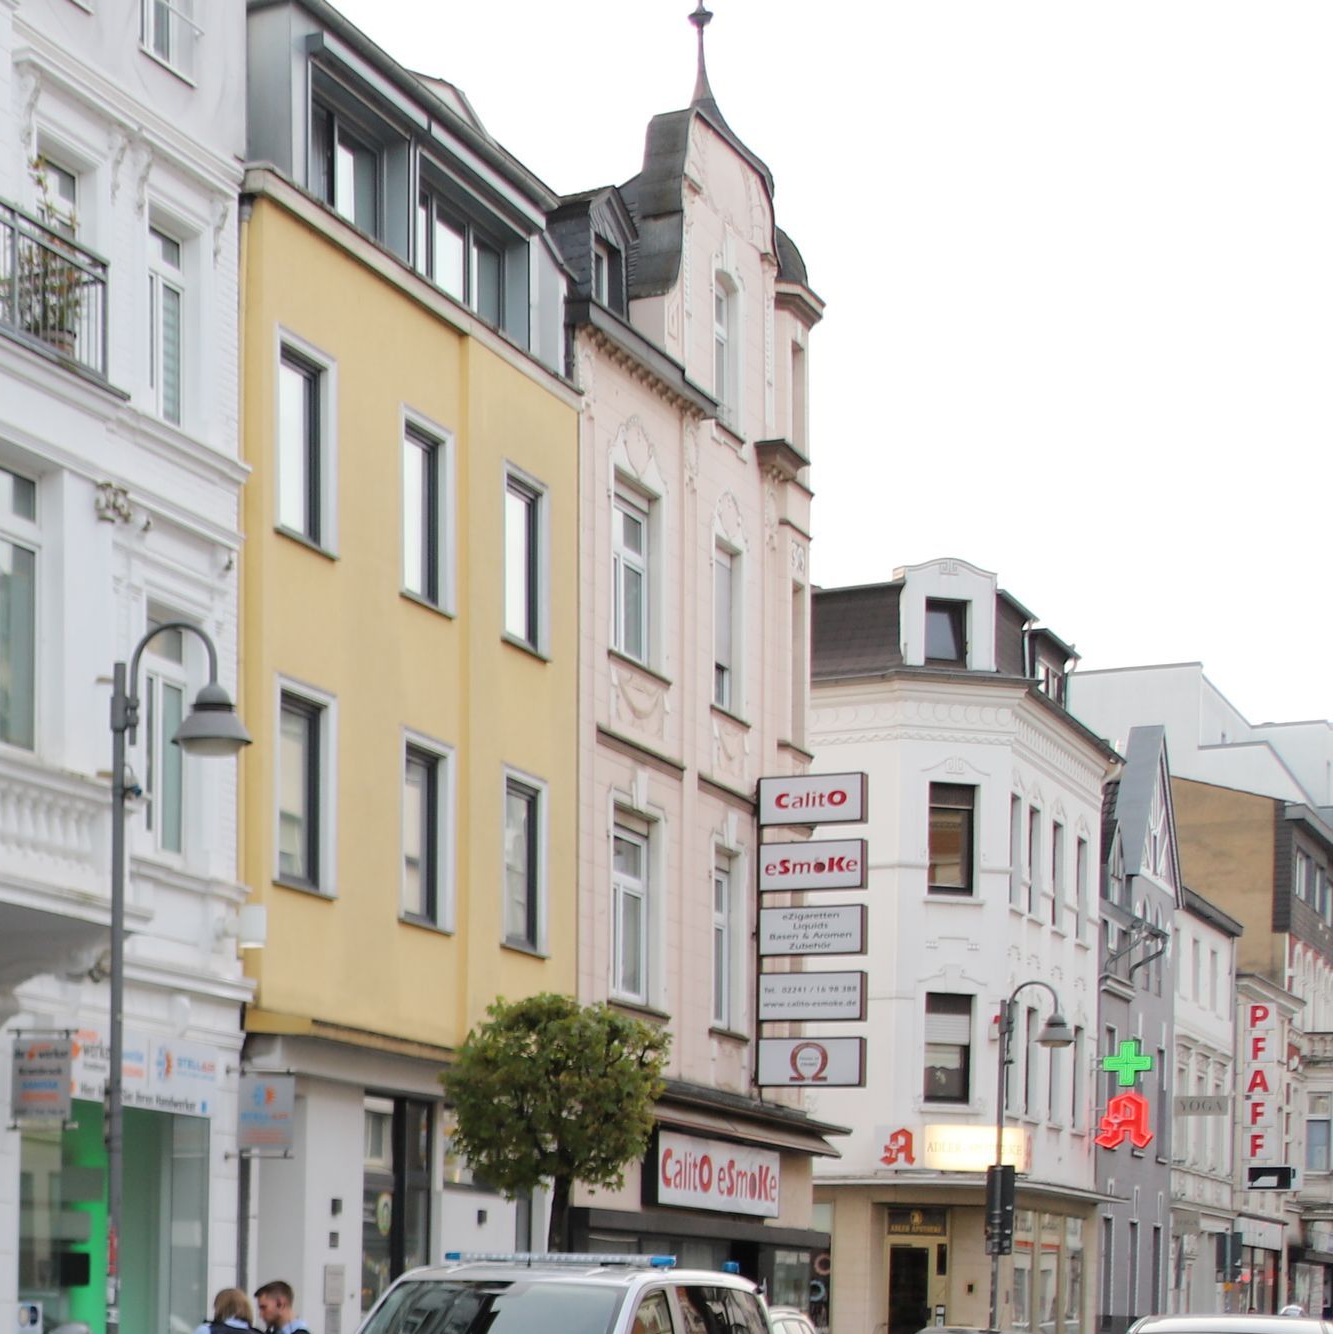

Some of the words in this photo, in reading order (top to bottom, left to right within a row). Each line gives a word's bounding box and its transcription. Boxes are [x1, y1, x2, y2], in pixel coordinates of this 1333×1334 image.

[774, 790, 847, 810] CalitO
[765, 857, 857, 876] eSmoKe
[782, 911, 840, 921] eZigaretten
[793, 922, 828, 931] Liquids
[813, 931, 852, 939] Aromen
[1248, 1005, 1270, 1158] PFAFF
[1180, 1099, 1223, 1112] YOGA
[661, 1148, 713, 1193] CalitO
[717, 1159, 777, 1202] eSmoKe
